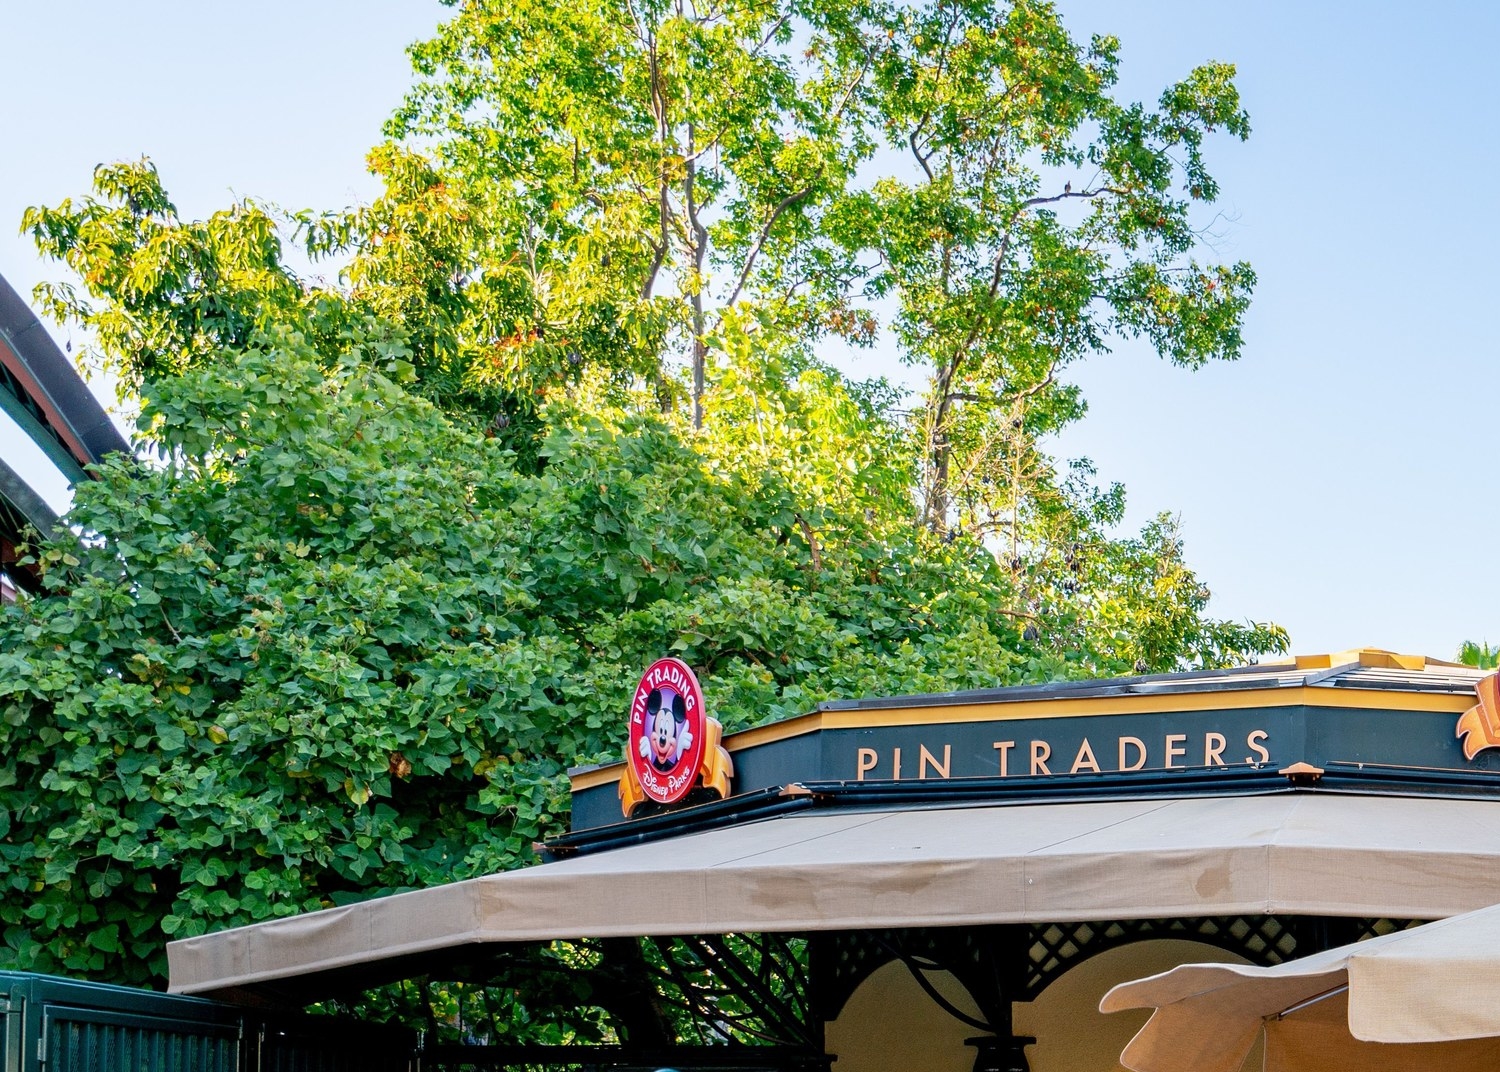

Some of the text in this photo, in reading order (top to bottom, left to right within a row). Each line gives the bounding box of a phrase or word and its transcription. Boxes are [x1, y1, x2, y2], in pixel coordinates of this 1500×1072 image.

[634, 665, 695, 725] PIN TRADING
[857, 730, 1272, 781] PIN TRADERS
